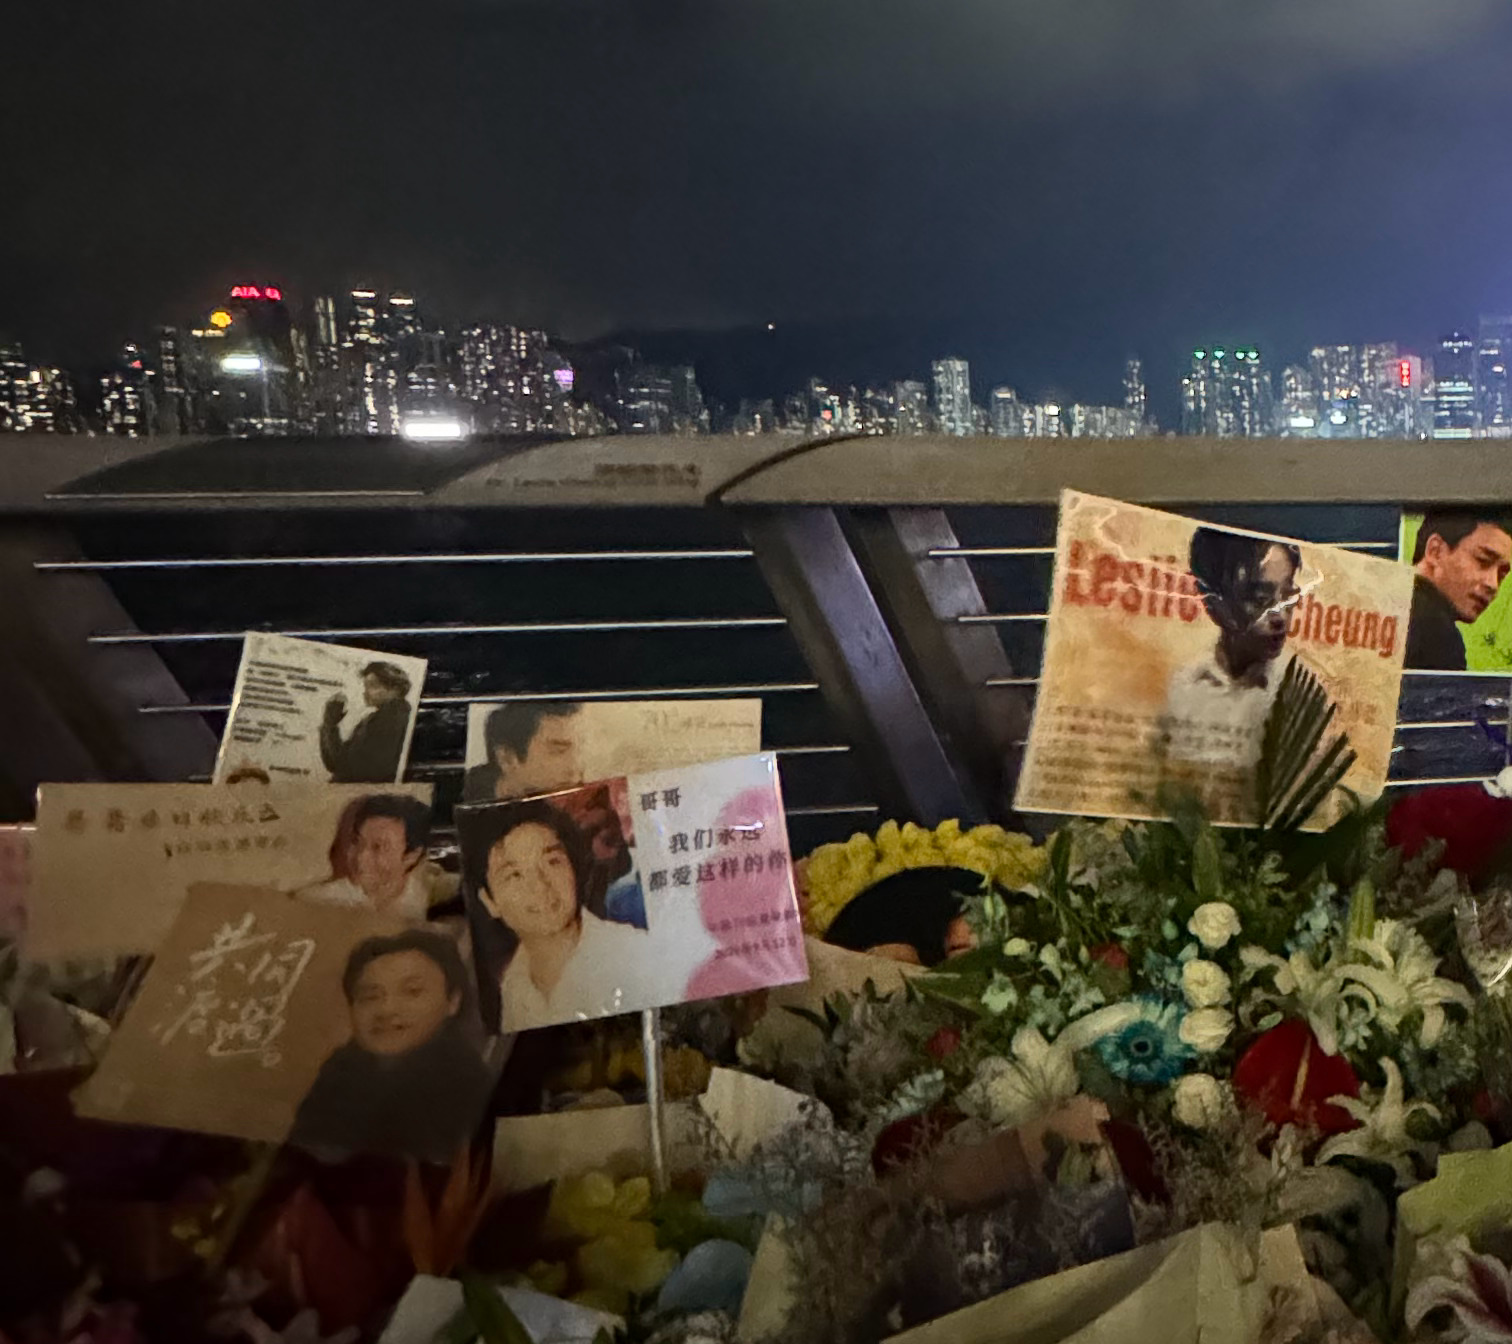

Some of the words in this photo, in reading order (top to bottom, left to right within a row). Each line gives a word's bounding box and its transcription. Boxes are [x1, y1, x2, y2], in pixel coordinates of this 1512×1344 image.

[231, 286, 260, 298] AIA
[1063, 540, 1201, 622] Leslie
[639, 787, 681, 812] 哥哥
[669, 826, 761, 854] 我们永远
[650, 849, 788, 892] 都爱这样的你
